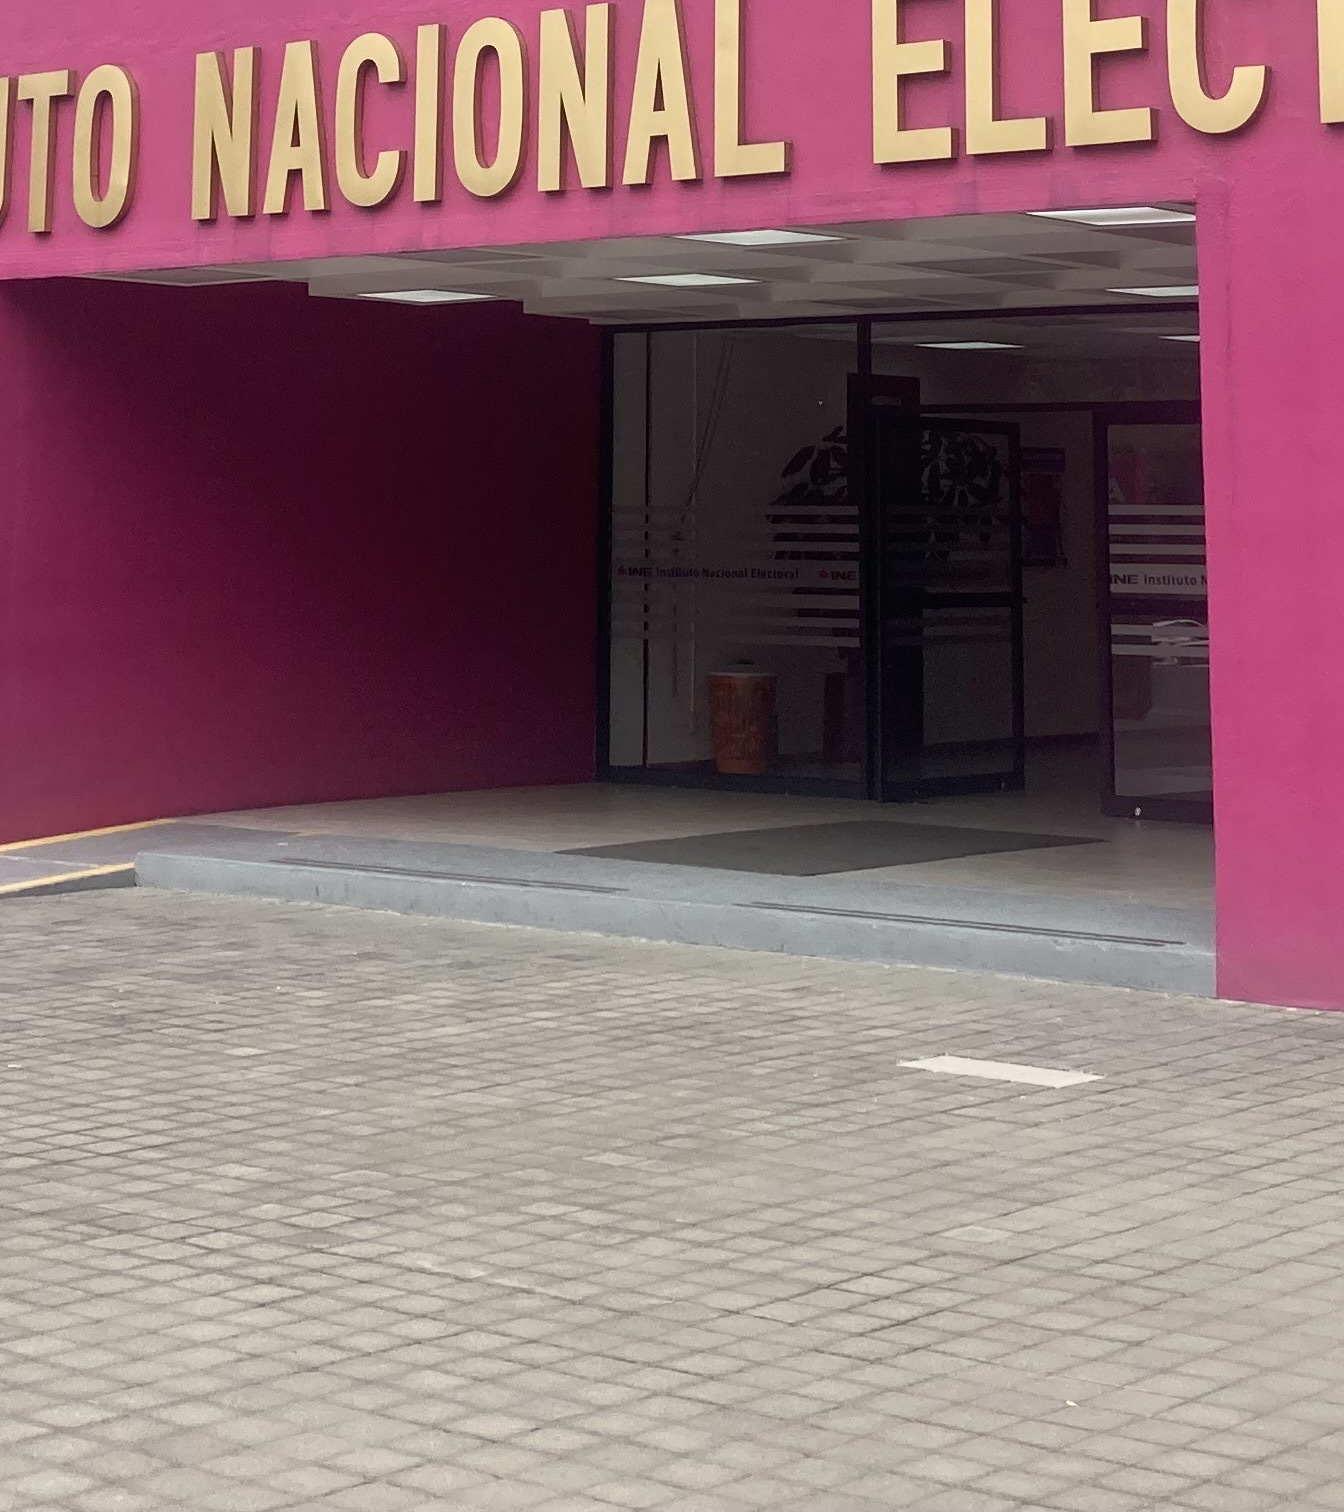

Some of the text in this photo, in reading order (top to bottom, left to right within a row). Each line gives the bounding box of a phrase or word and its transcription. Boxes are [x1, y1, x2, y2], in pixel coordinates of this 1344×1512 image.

[627, 567, 652, 577] INE
[702, 568, 748, 579] Nacional
[750, 568, 799, 580] Electoral
[830, 570, 857, 580] INE
[1144, 574, 1197, 586] Instituto
